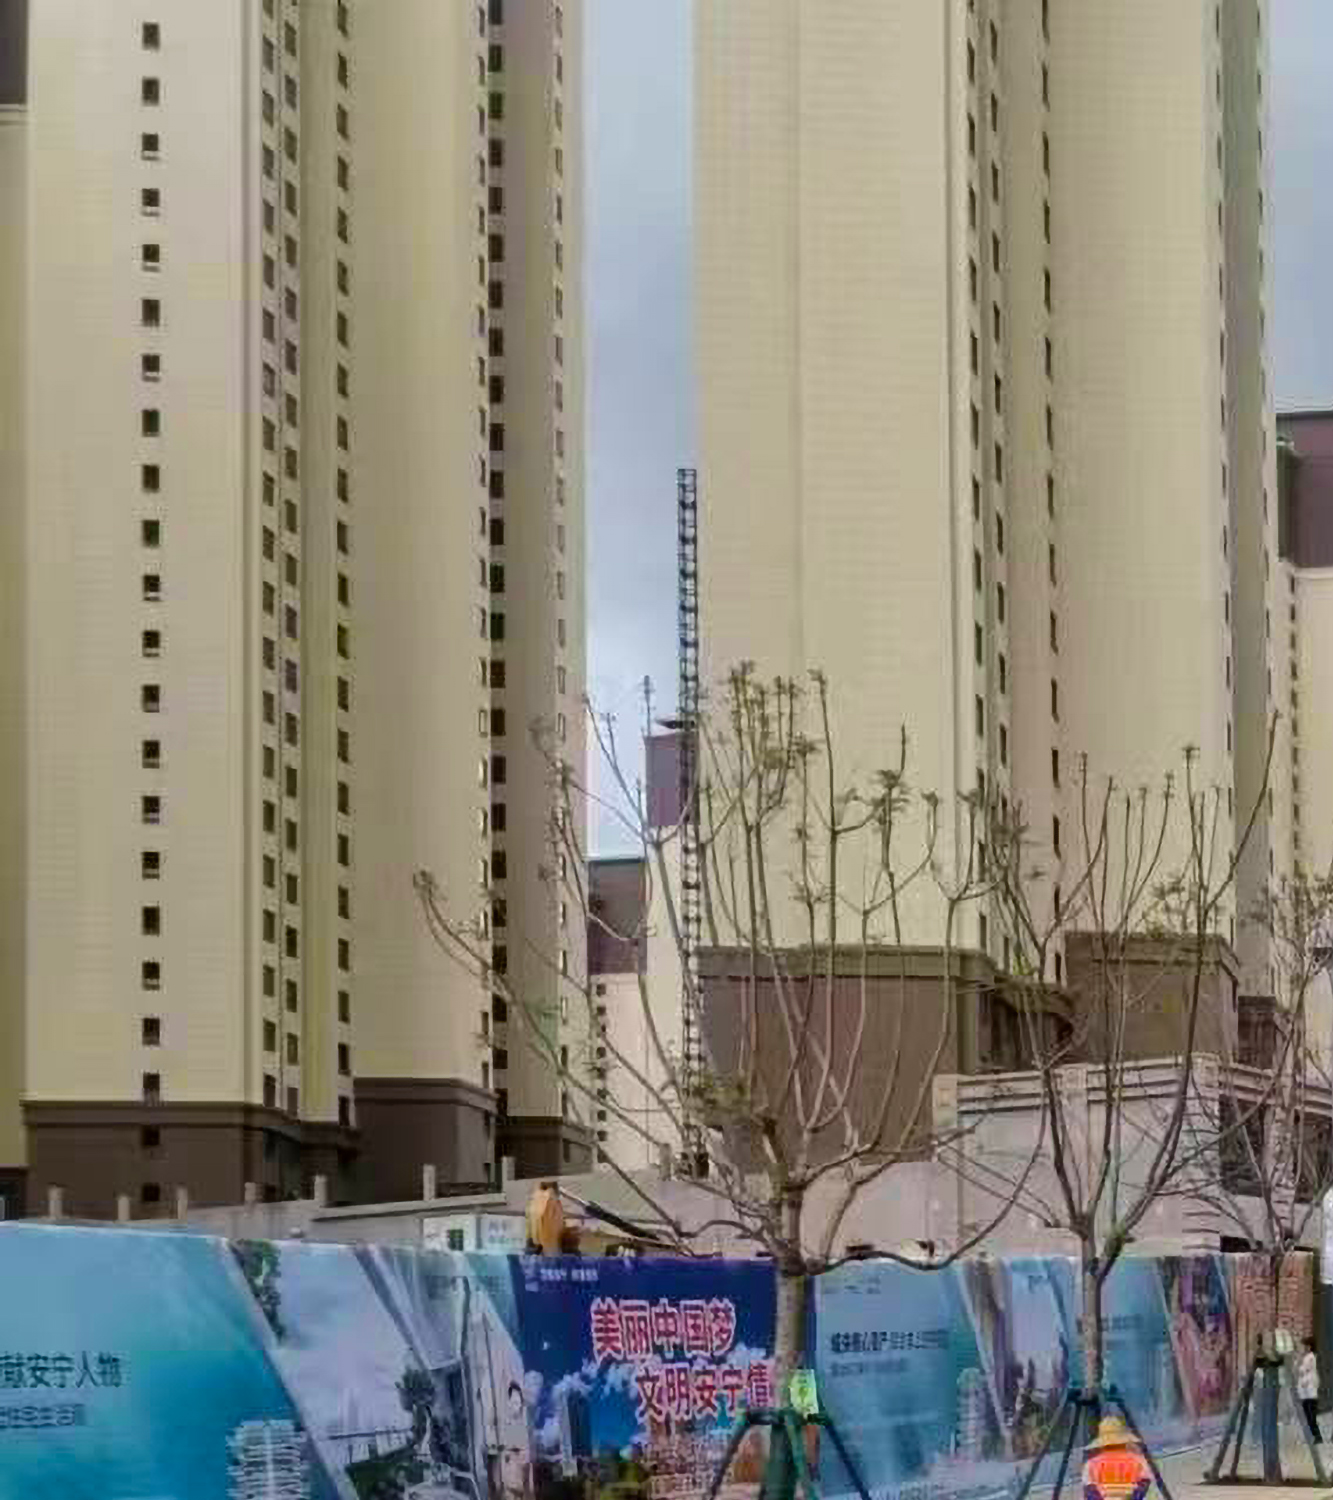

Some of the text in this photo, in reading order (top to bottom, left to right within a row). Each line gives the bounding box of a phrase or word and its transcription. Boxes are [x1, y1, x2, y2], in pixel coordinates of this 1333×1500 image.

[591, 1298, 737, 1362] 美丽中国梦
